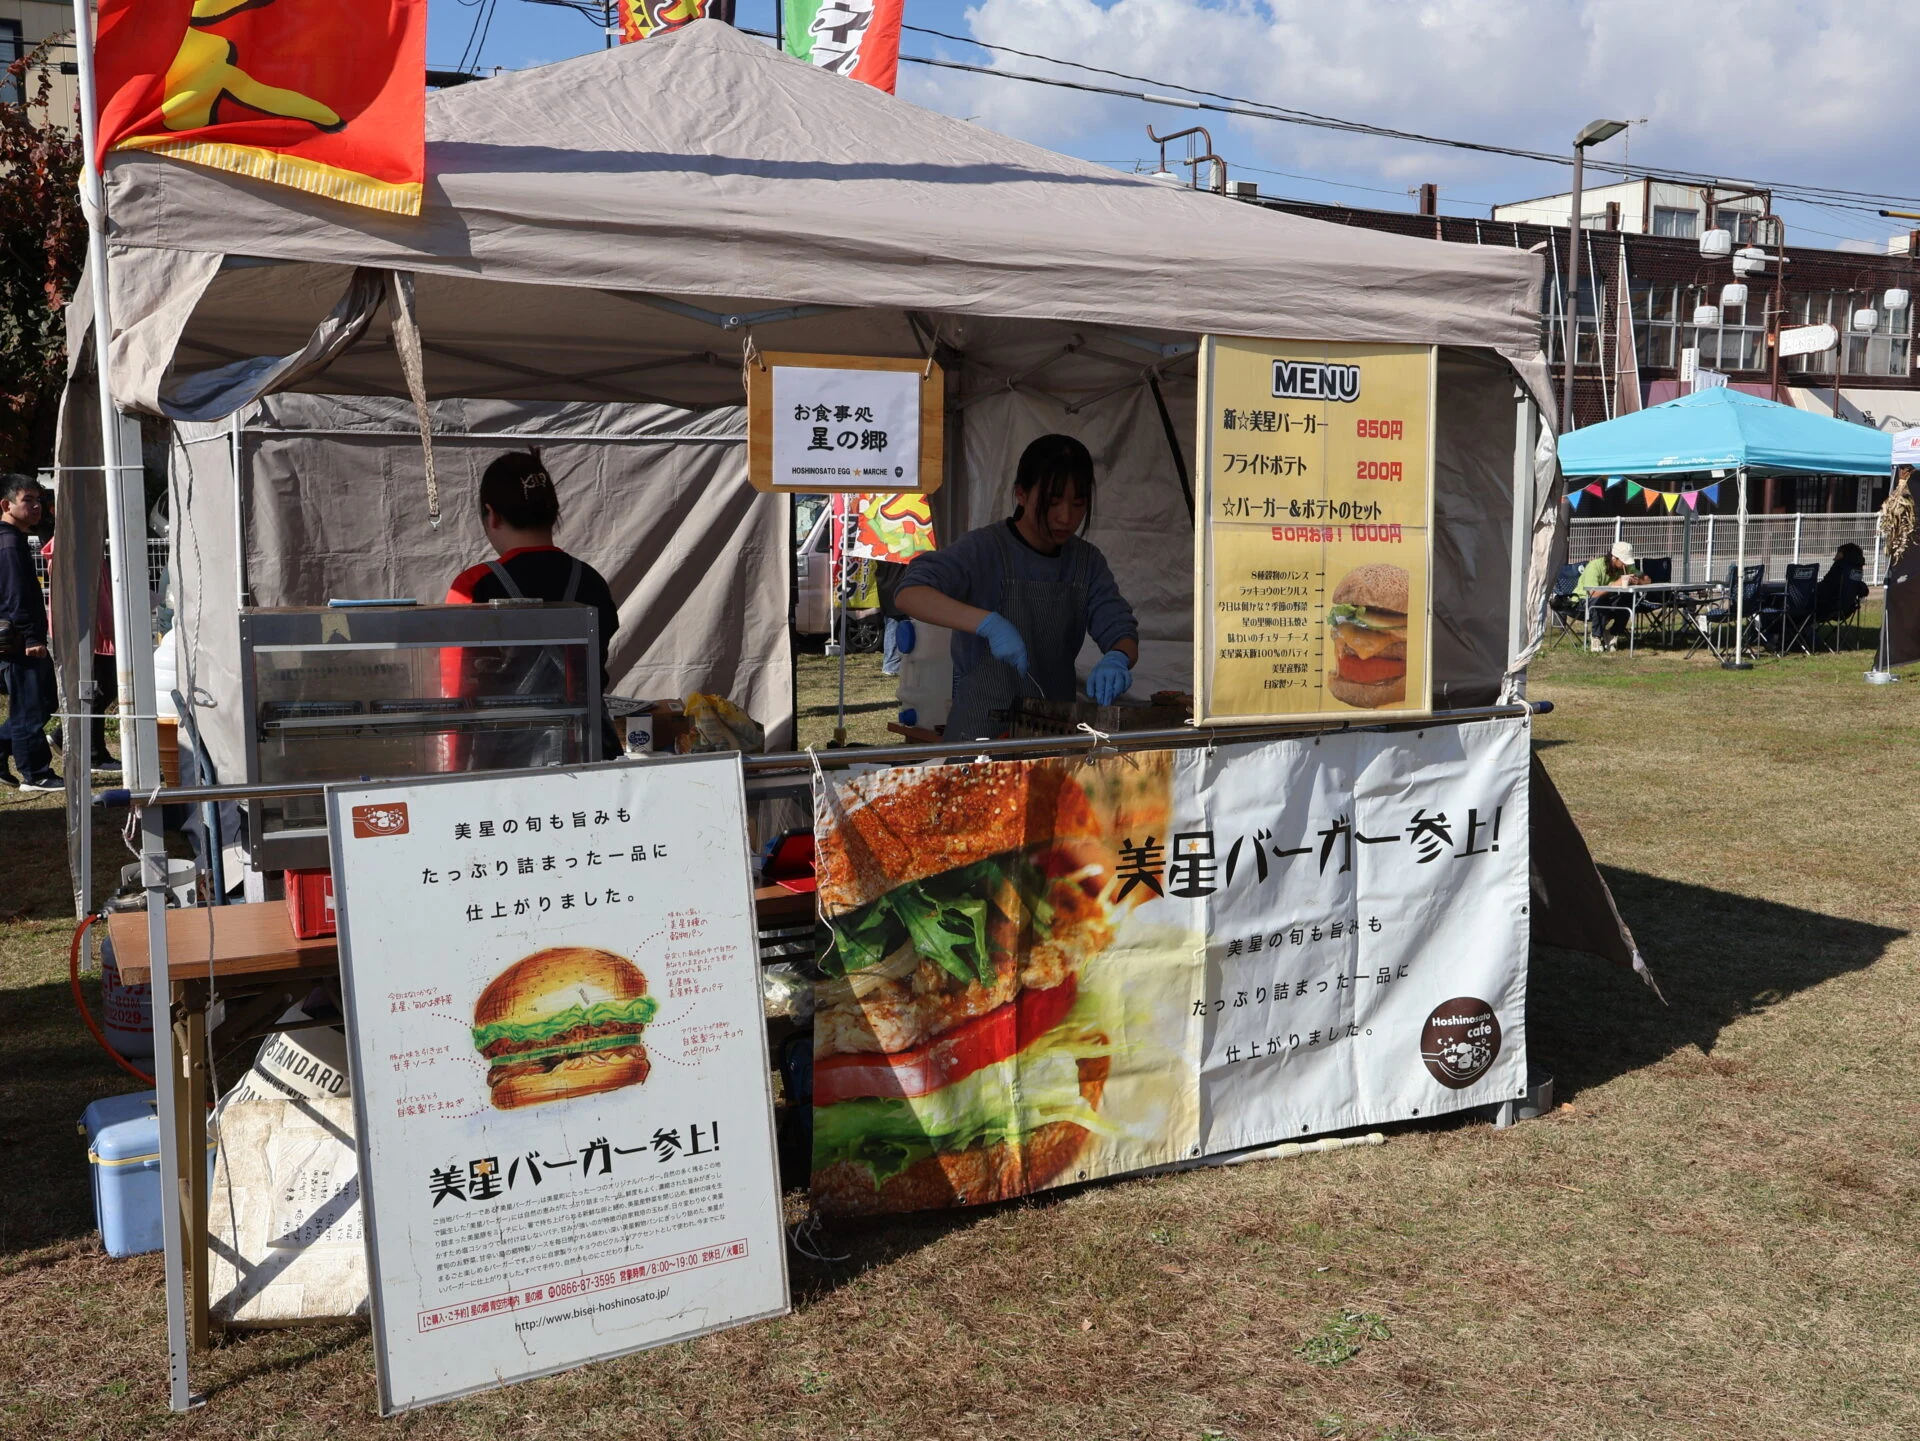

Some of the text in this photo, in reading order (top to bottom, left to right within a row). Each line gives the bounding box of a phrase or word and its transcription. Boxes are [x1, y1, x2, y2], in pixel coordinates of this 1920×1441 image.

[1273, 360, 1360, 402] MENU
[794, 404, 874, 423] お食事処
[1357, 419, 1403, 440] 850円
[807, 427, 888, 452] 星の郷
[792, 467, 888, 476] HOSHINOSATO EGG MARCHE
[1223, 454, 1403, 482] フライドポテト 200円
[1349, 523, 1402, 543] 1000円
[453, 805, 632, 841] 美星の旬も旨みも
[421, 841, 668, 886] たっぷり詰まった一品に
[465, 884, 636, 922] 仕上がりました。
[1227, 916, 1383, 958] 美星の旬も旨みも
[1192, 963, 1410, 1017] たっぷり詰まった一品に
[1432, 1012, 1491, 1027] Hoshinosato
[1467, 1022, 1492, 1038] cafe
[1225, 1020, 1374, 1065] 仕上がりました。
[265, 1038, 344, 1094] STANDARD
[515, 1286, 670, 1334] http://www.bisei-hoshinosato.jp/
[524, 1289, 543, 1303] 星の郷
